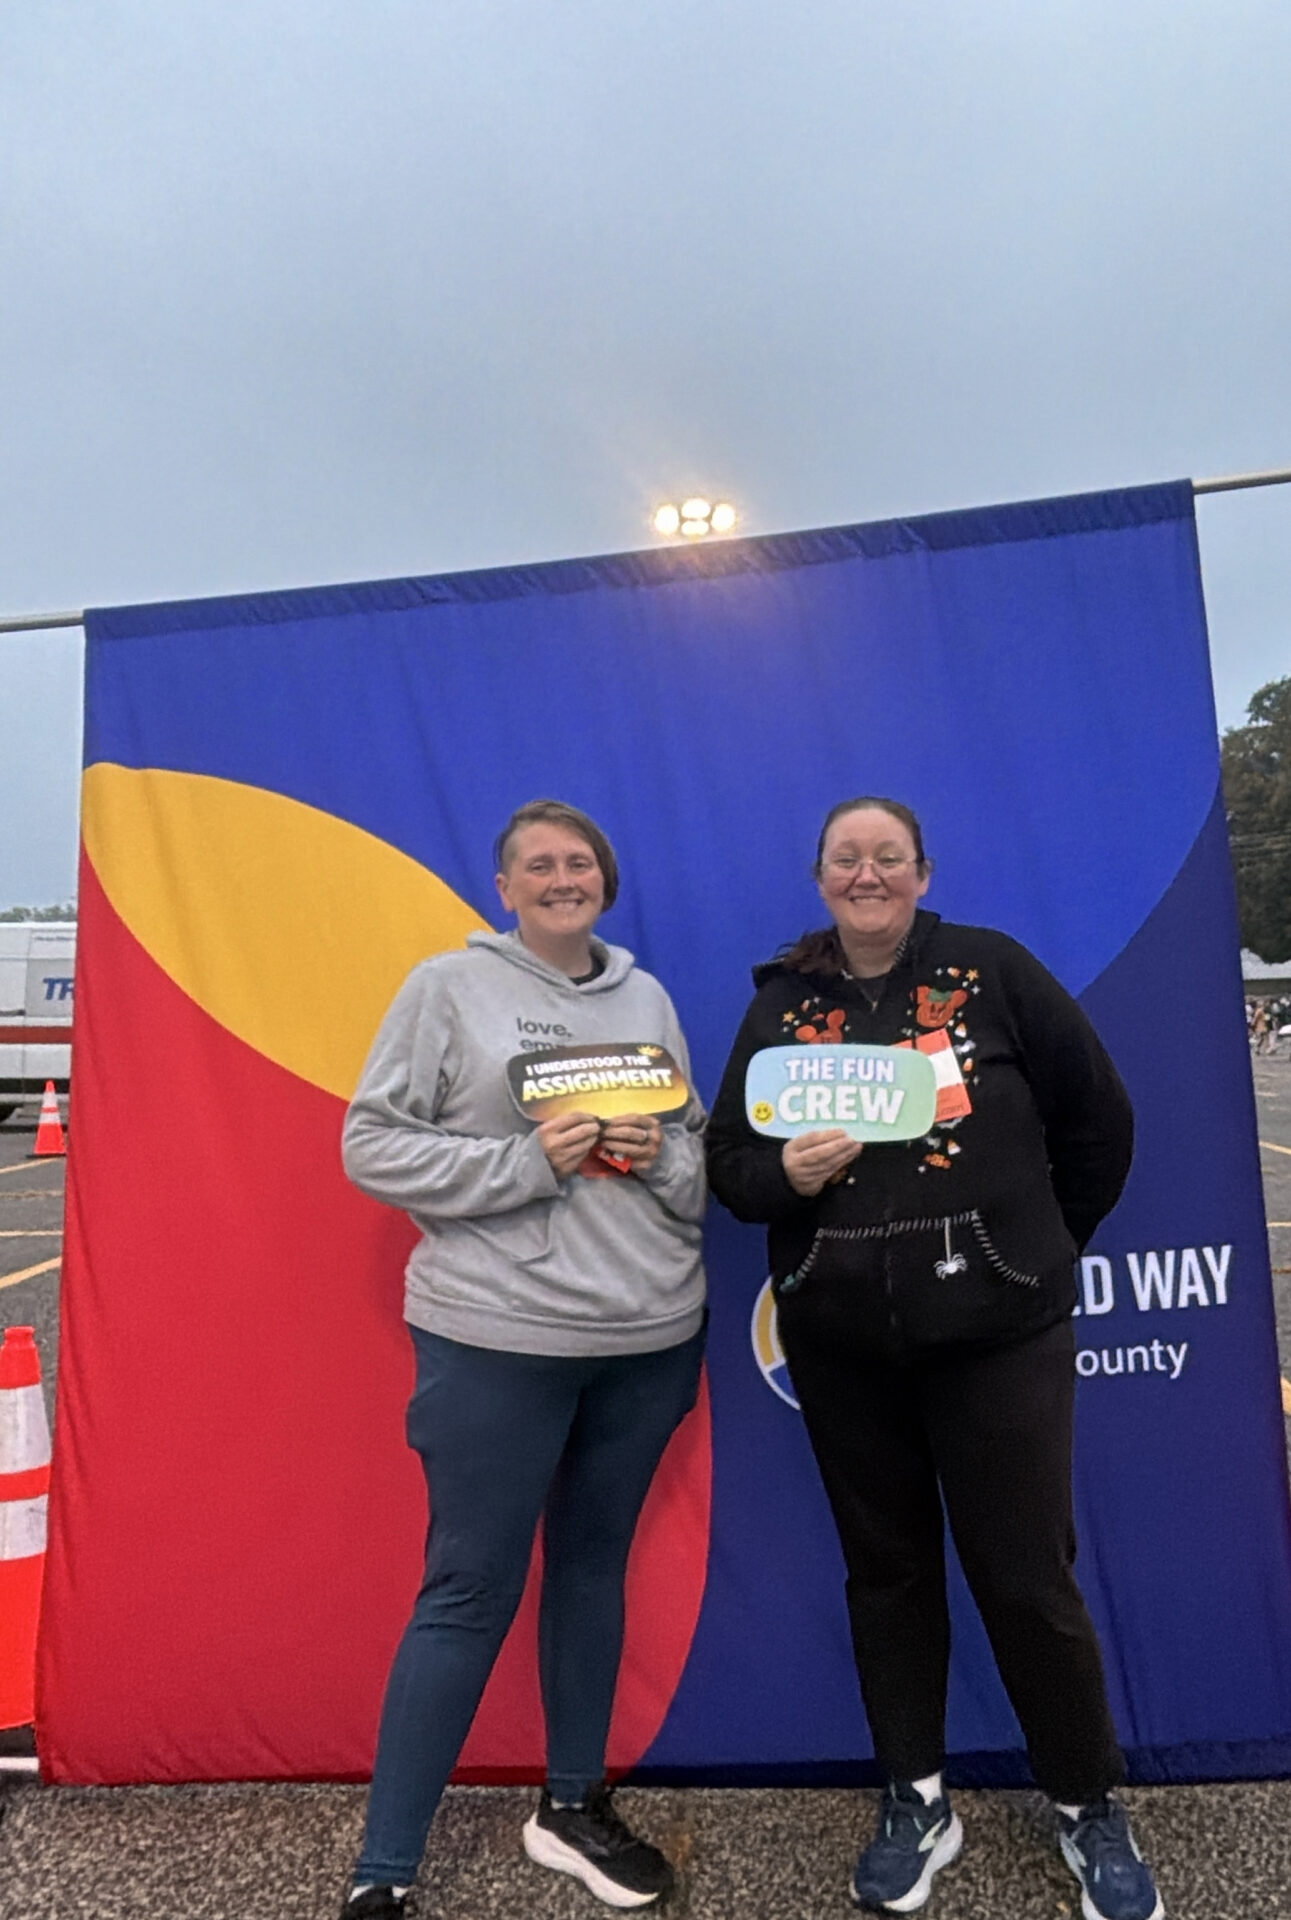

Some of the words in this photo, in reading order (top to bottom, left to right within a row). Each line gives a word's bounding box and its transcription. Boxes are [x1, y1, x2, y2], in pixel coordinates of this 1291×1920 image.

[526, 1065, 533, 1076] I
[535, 1056, 623, 1072] UNDERSTOOD
[625, 1055, 652, 1066] THE
[786, 1057, 835, 1081] THE
[842, 1059, 895, 1083] FUN
[522, 1069, 673, 1102] ASSIGNMENT
[777, 1084, 905, 1125] CREW
[1072, 1255, 1115, 1316] D
[1126, 1244, 1233, 1312] WAY
